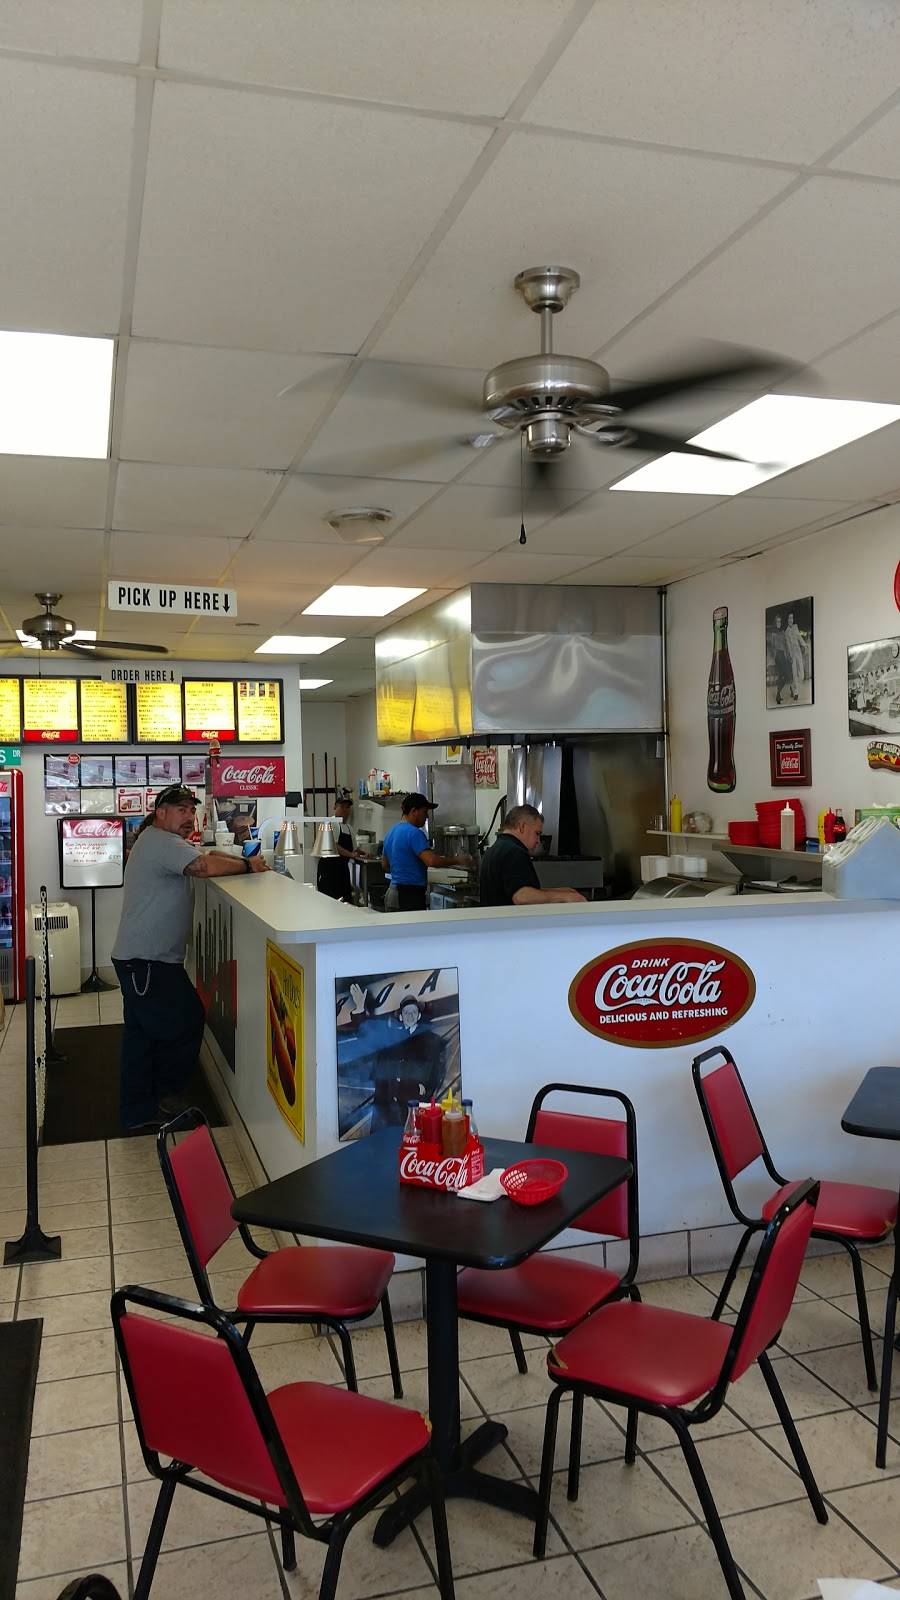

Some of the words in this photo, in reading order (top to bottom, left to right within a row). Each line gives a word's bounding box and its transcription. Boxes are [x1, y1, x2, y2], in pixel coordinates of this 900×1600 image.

[118, 587, 151, 606] PICK
[159, 589, 177, 608] UP
[184, 591, 220, 610] HERE
[111, 669, 140, 681] ORDER
[144, 669, 167, 681] HERE
[12, 749, 21, 757] DR
[221, 764, 276, 785] Coca-Cola
[630, 957, 671, 968] DRINK
[594, 959, 726, 1012] Coca-Cola
[599, 1012, 647, 1024] DELICIOUS
[649, 1010, 669, 1021] AND
[672, 1006, 728, 1019] REFRESHING
[399, 1151, 470, 1189] Coca-Cola
